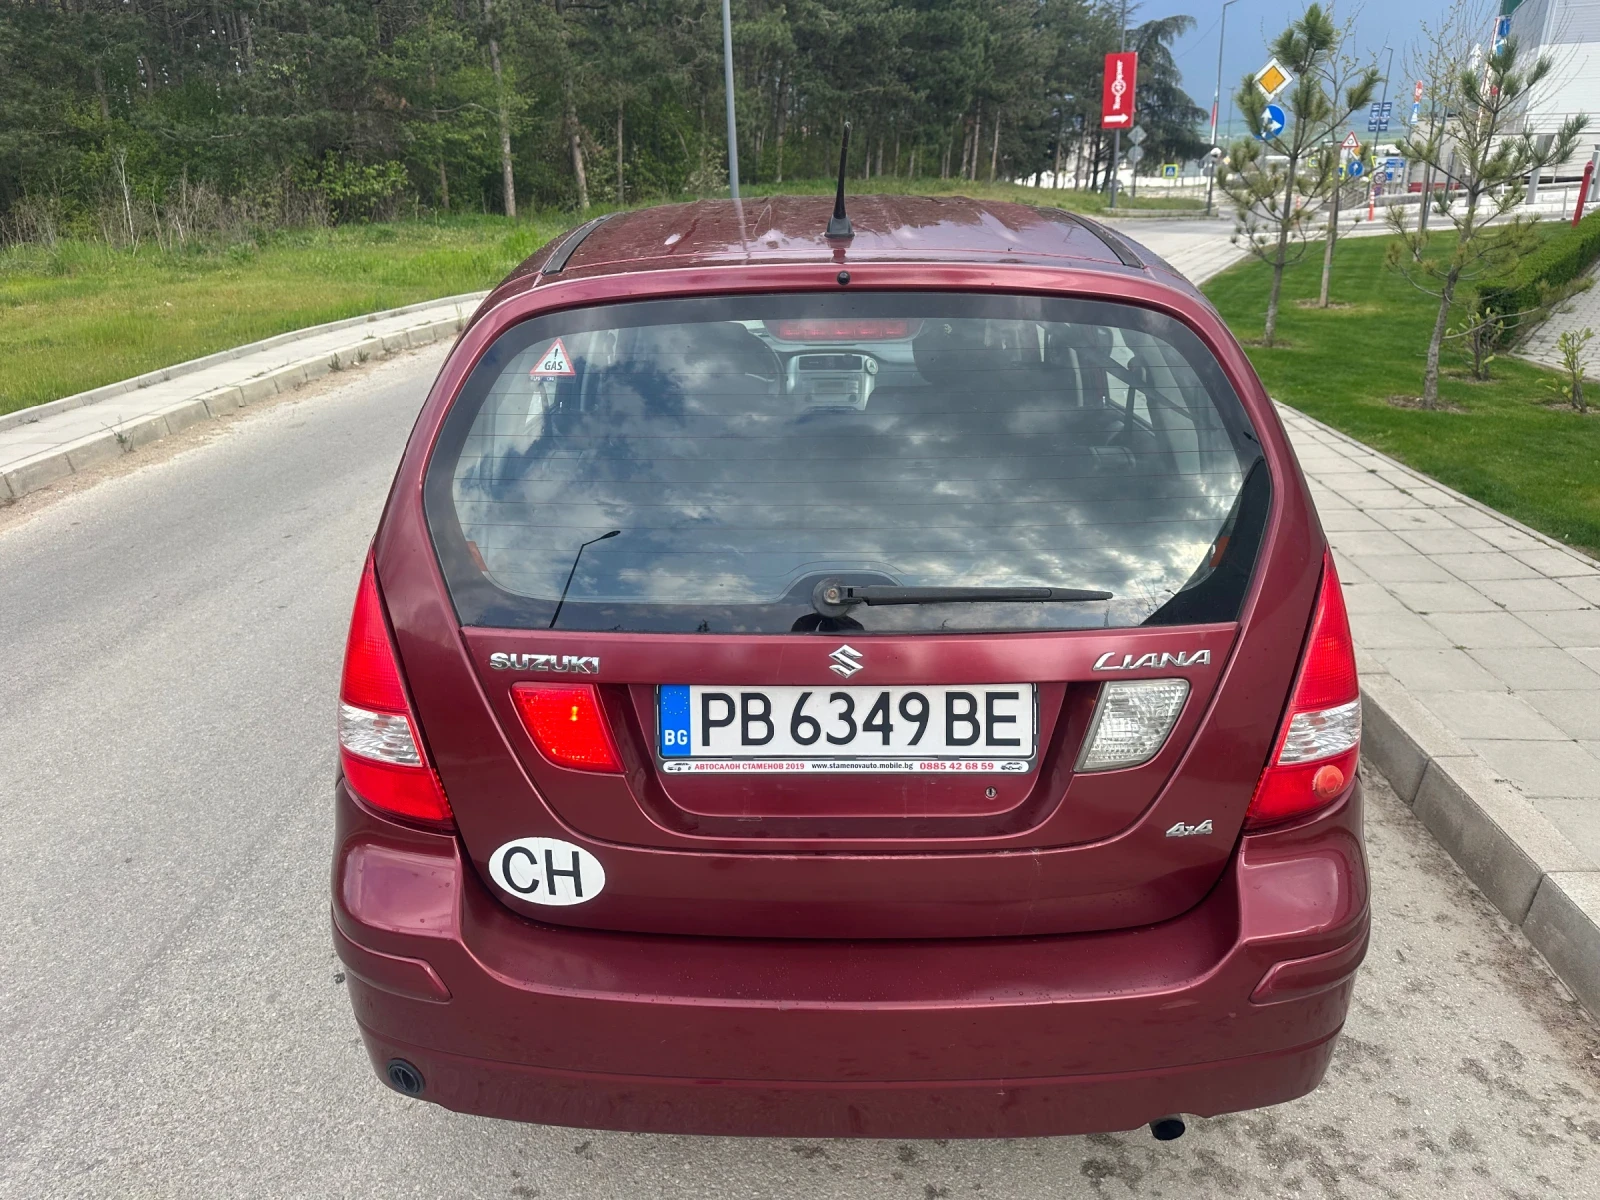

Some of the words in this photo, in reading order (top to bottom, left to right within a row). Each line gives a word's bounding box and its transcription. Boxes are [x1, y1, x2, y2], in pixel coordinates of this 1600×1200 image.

[544, 361, 563, 371] GAS
[490, 652, 600, 674] SUZUKI
[1093, 649, 1211, 671] LIANA
[701, 692, 775, 746] PB
[790, 691, 930, 746] 6349
[945, 691, 1021, 746] BE
[664, 730, 688, 746] BG
[811, 762, 914, 770] www.stamenovauto.mobile.bg
[919, 762, 946, 770] 0885
[949, 762, 962, 770] 42
[965, 762, 978, 770] 68
[981, 762, 994, 770] 59
[1166, 819, 1213, 838] 4x4
[502, 846, 583, 898] CH
